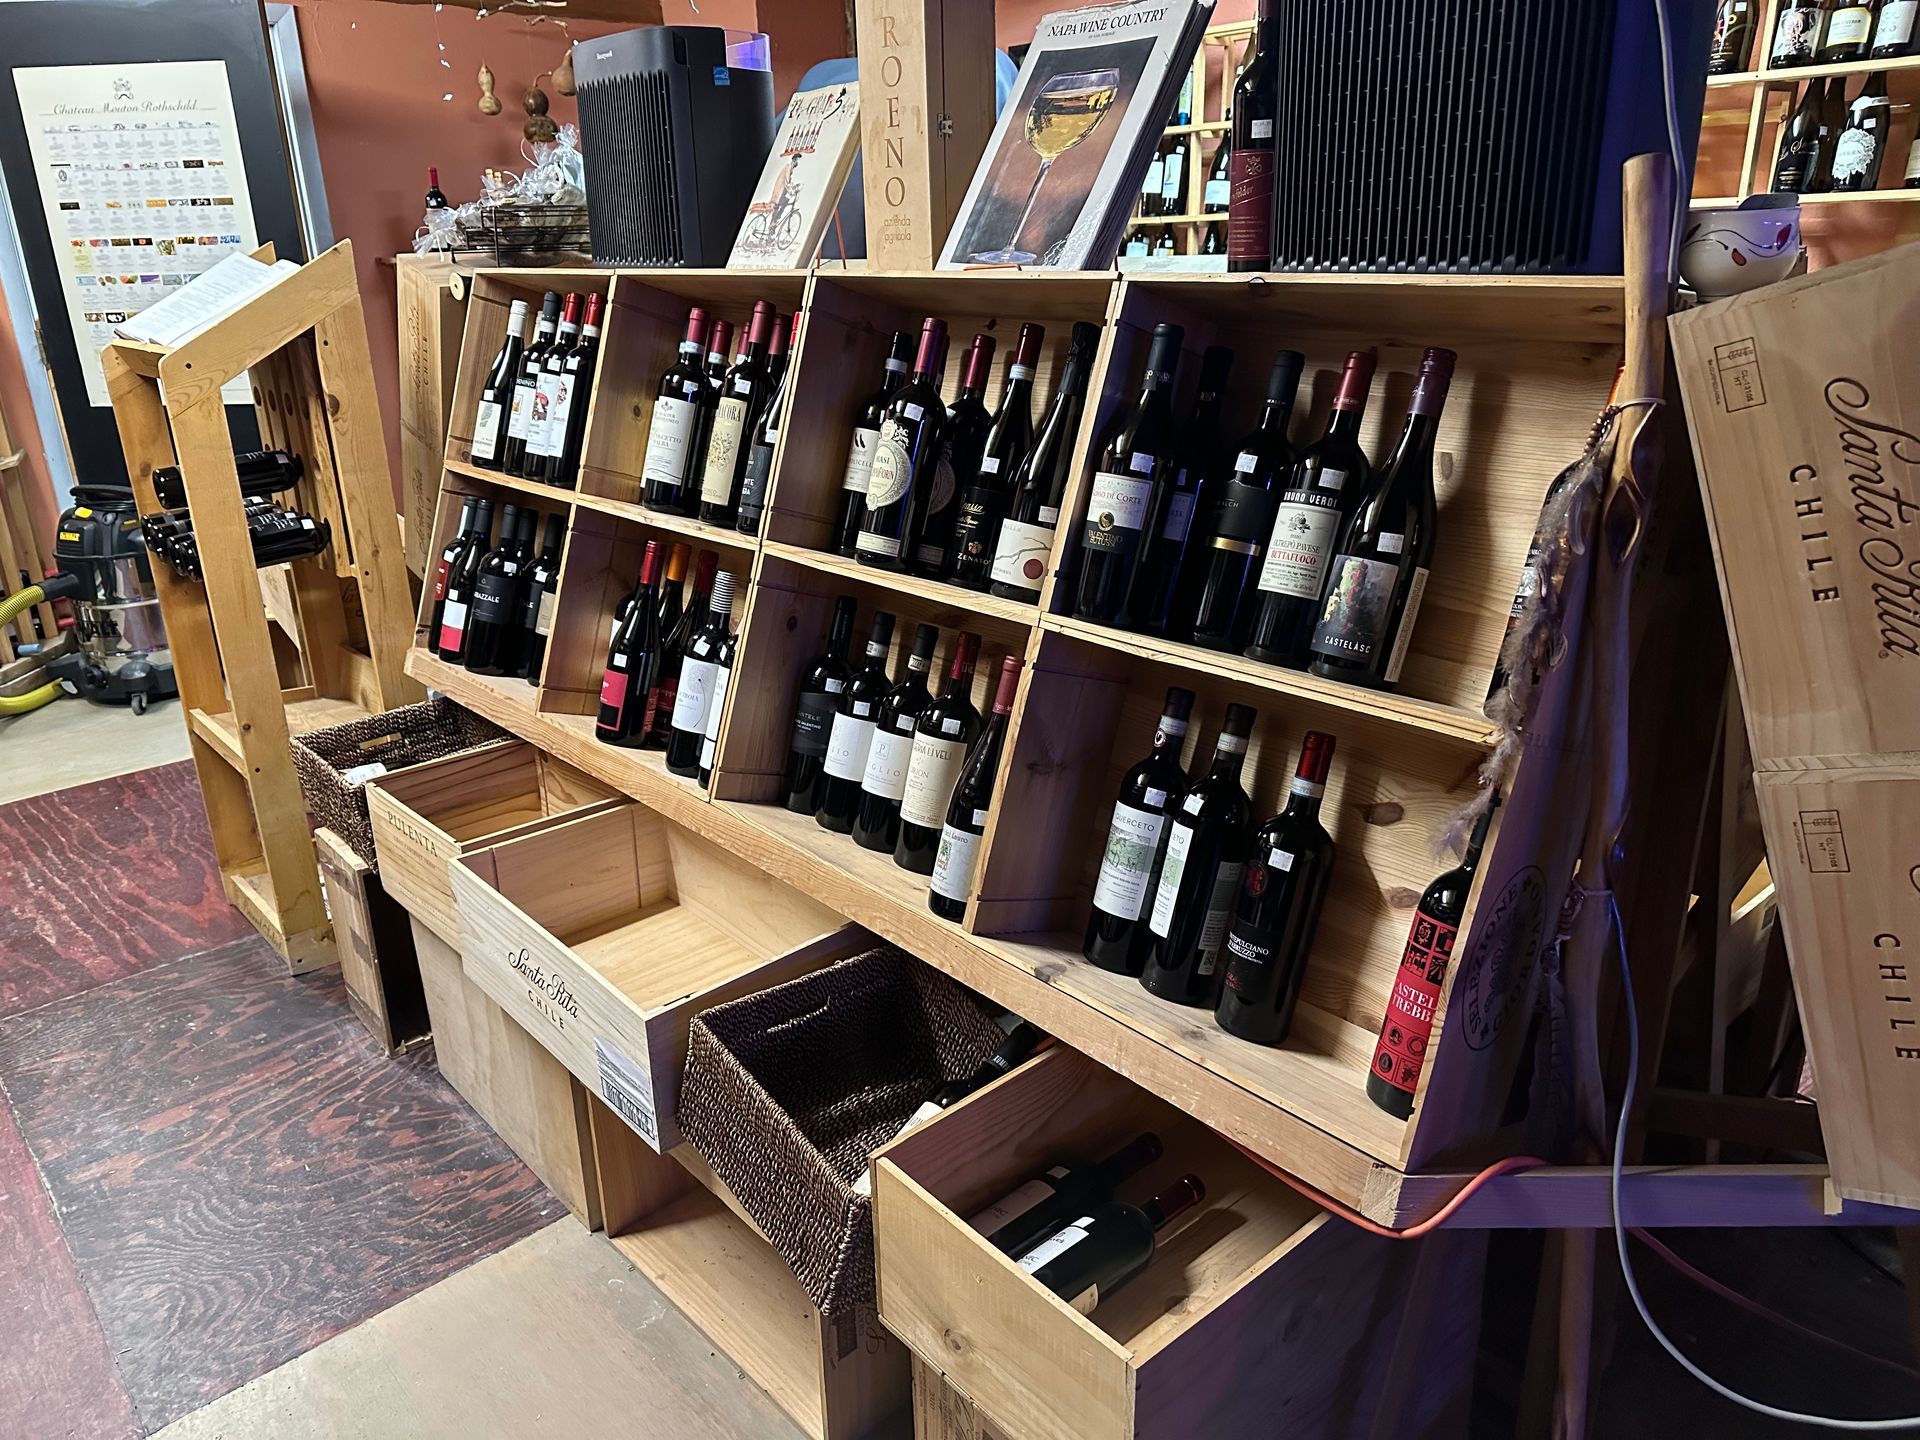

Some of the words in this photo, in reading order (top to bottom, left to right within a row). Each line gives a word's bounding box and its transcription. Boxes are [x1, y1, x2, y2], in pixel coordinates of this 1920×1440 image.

[1047, 25, 1077, 37] NAPA
[1079, 18, 1110, 33] WINE
[1110, 8, 1168, 29] COUNTRY
[141, 99, 197, 112] Rothschild
[879, 16, 906, 207] ROENO
[884, 215, 911, 227] azienda
[884, 232, 912, 244] agricola
[1824, 377, 1920, 533] Santa
[1309, 494, 1338, 508] VERDI
[1296, 542, 1321, 554] PAVESE
[1789, 464, 1840, 602] CHILE
[387, 810, 437, 857] PULENTA
[1115, 812, 1155, 832] QUERCETO
[508, 948, 545, 991] Santa
[546, 974, 578, 1018] Rita
[1873, 933, 1920, 1060] CHILE
[528, 990, 564, 1029] CHILE
